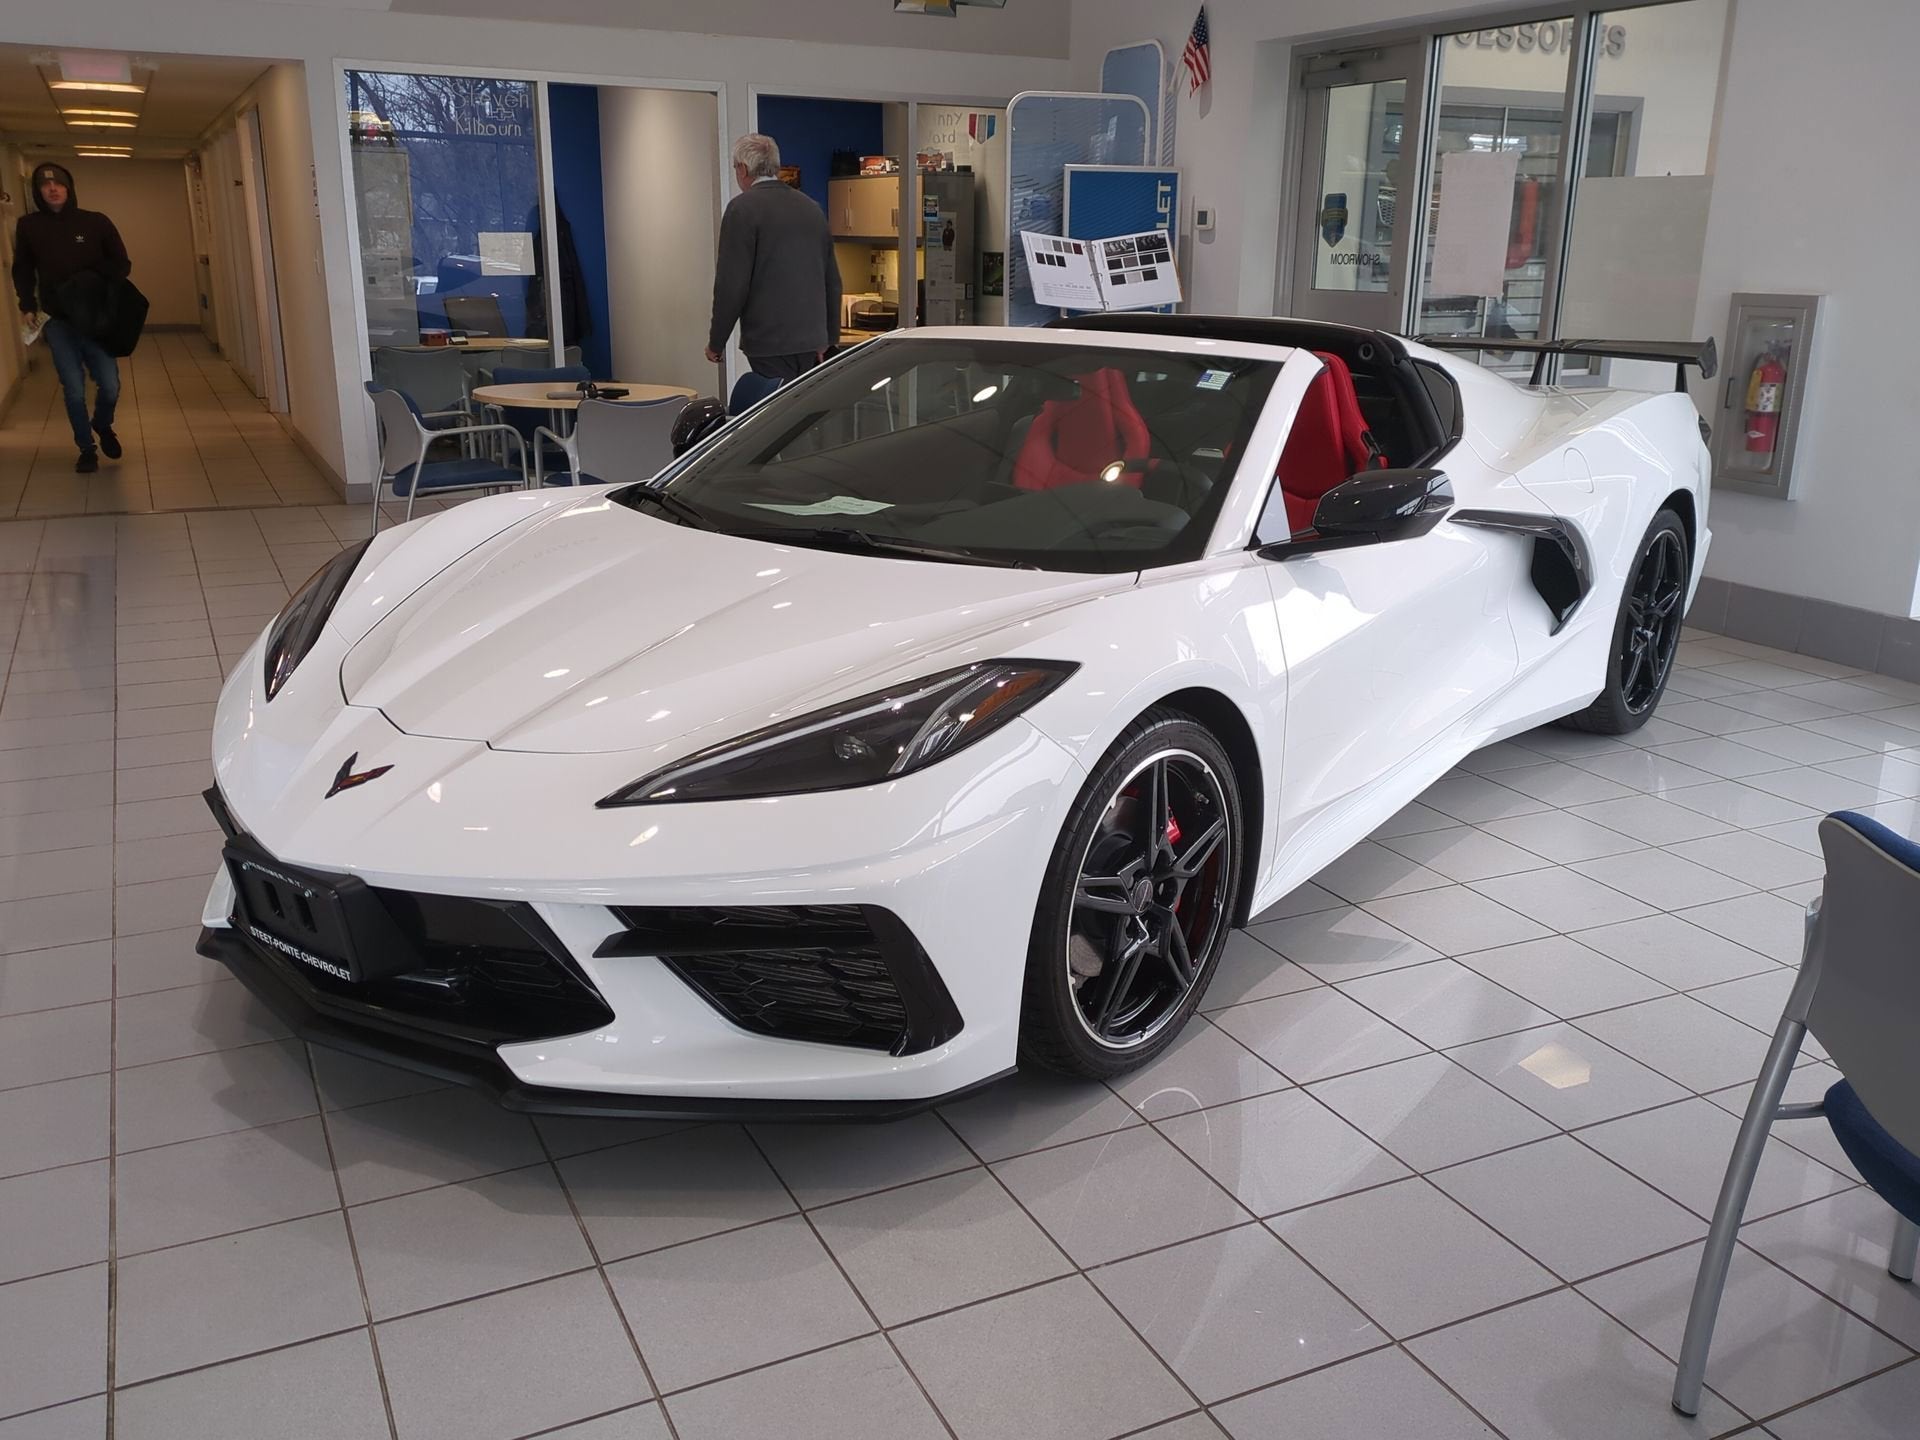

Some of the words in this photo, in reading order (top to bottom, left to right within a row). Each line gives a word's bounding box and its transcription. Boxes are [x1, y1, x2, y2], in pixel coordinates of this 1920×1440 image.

[451, 82, 529, 108] Steven
[454, 110, 522, 137] Kilbourn
[300, 951, 351, 982] CHEVROLET
